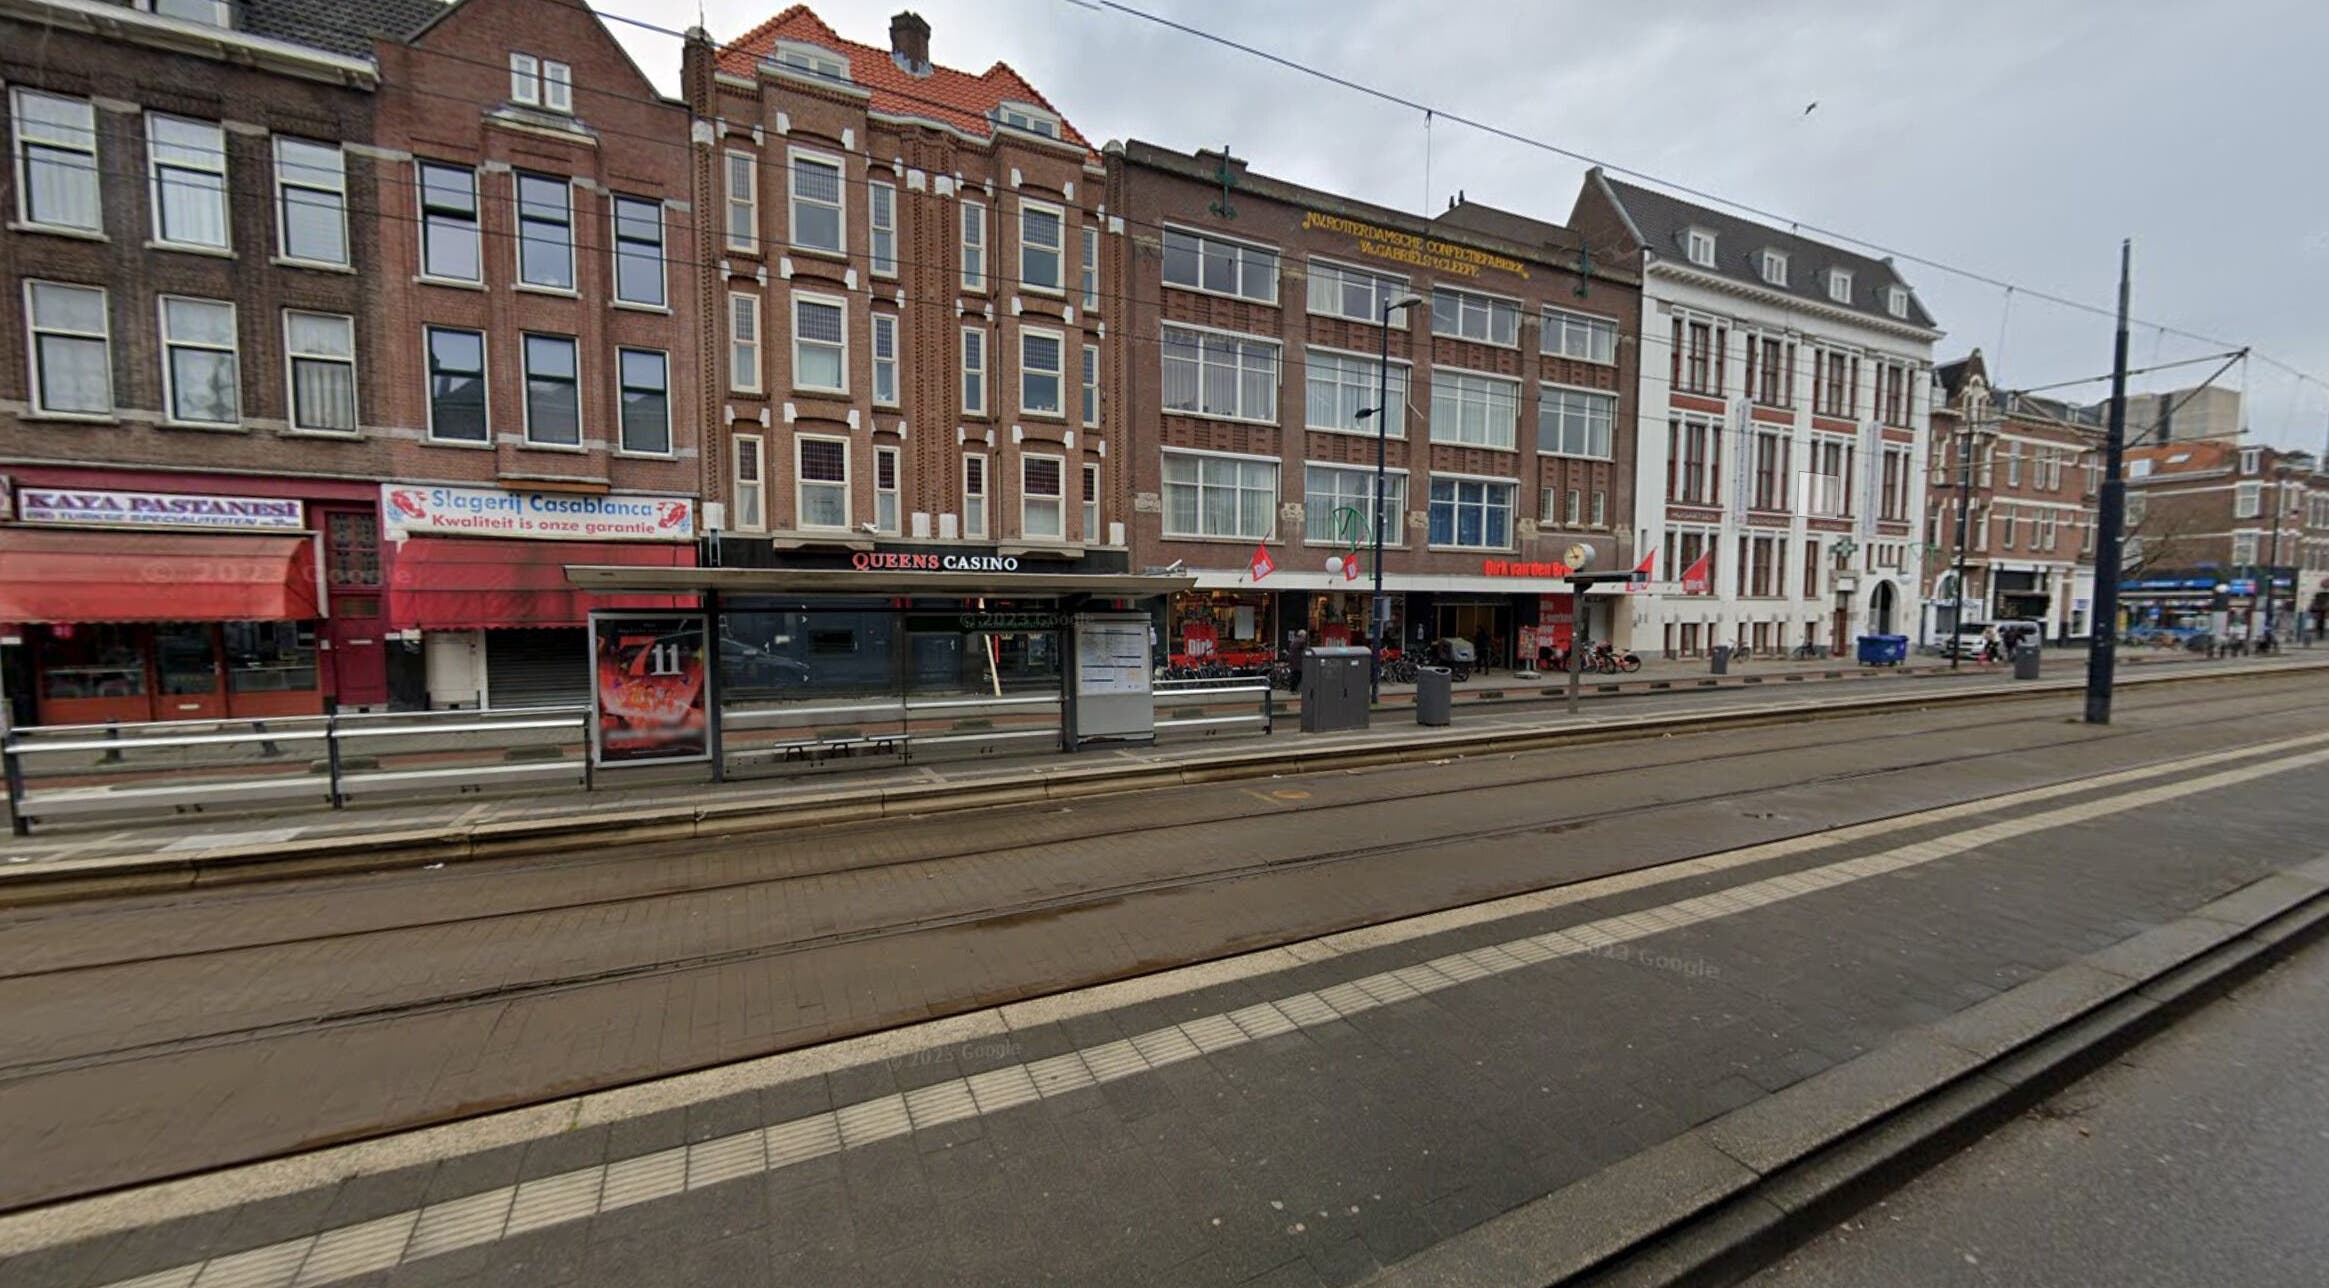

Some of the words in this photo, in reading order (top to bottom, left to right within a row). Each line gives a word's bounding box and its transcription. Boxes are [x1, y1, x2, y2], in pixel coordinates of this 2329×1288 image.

[23, 493, 121, 511] KAYA
[432, 489, 523, 515] Slagerij
[530, 493, 652, 516] Casablanca
[432, 514, 513, 530] Kwaliteit
[519, 516, 533, 530] is
[539, 519, 579, 532] onze
[585, 521, 656, 535] garantie
[852, 552, 940, 571] QUEENS
[943, 555, 1018, 571] CASINO
